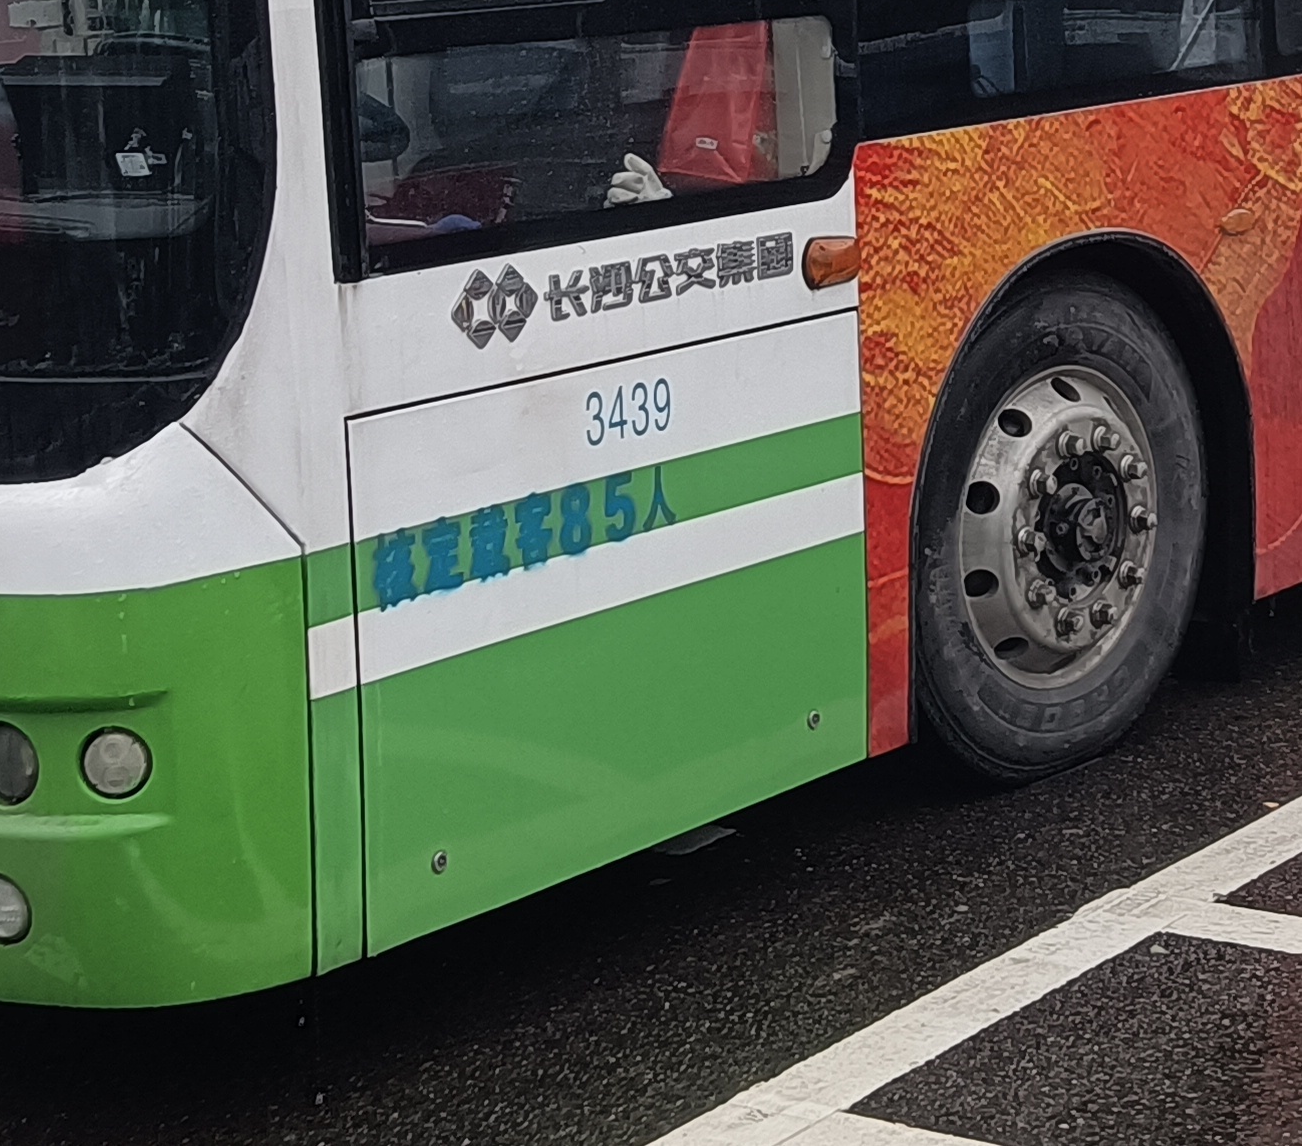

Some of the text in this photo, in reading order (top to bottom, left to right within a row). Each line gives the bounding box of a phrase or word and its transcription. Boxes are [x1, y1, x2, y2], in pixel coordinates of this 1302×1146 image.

[544, 231, 794, 322] 长沙公交集团
[586, 377, 672, 446] 3439
